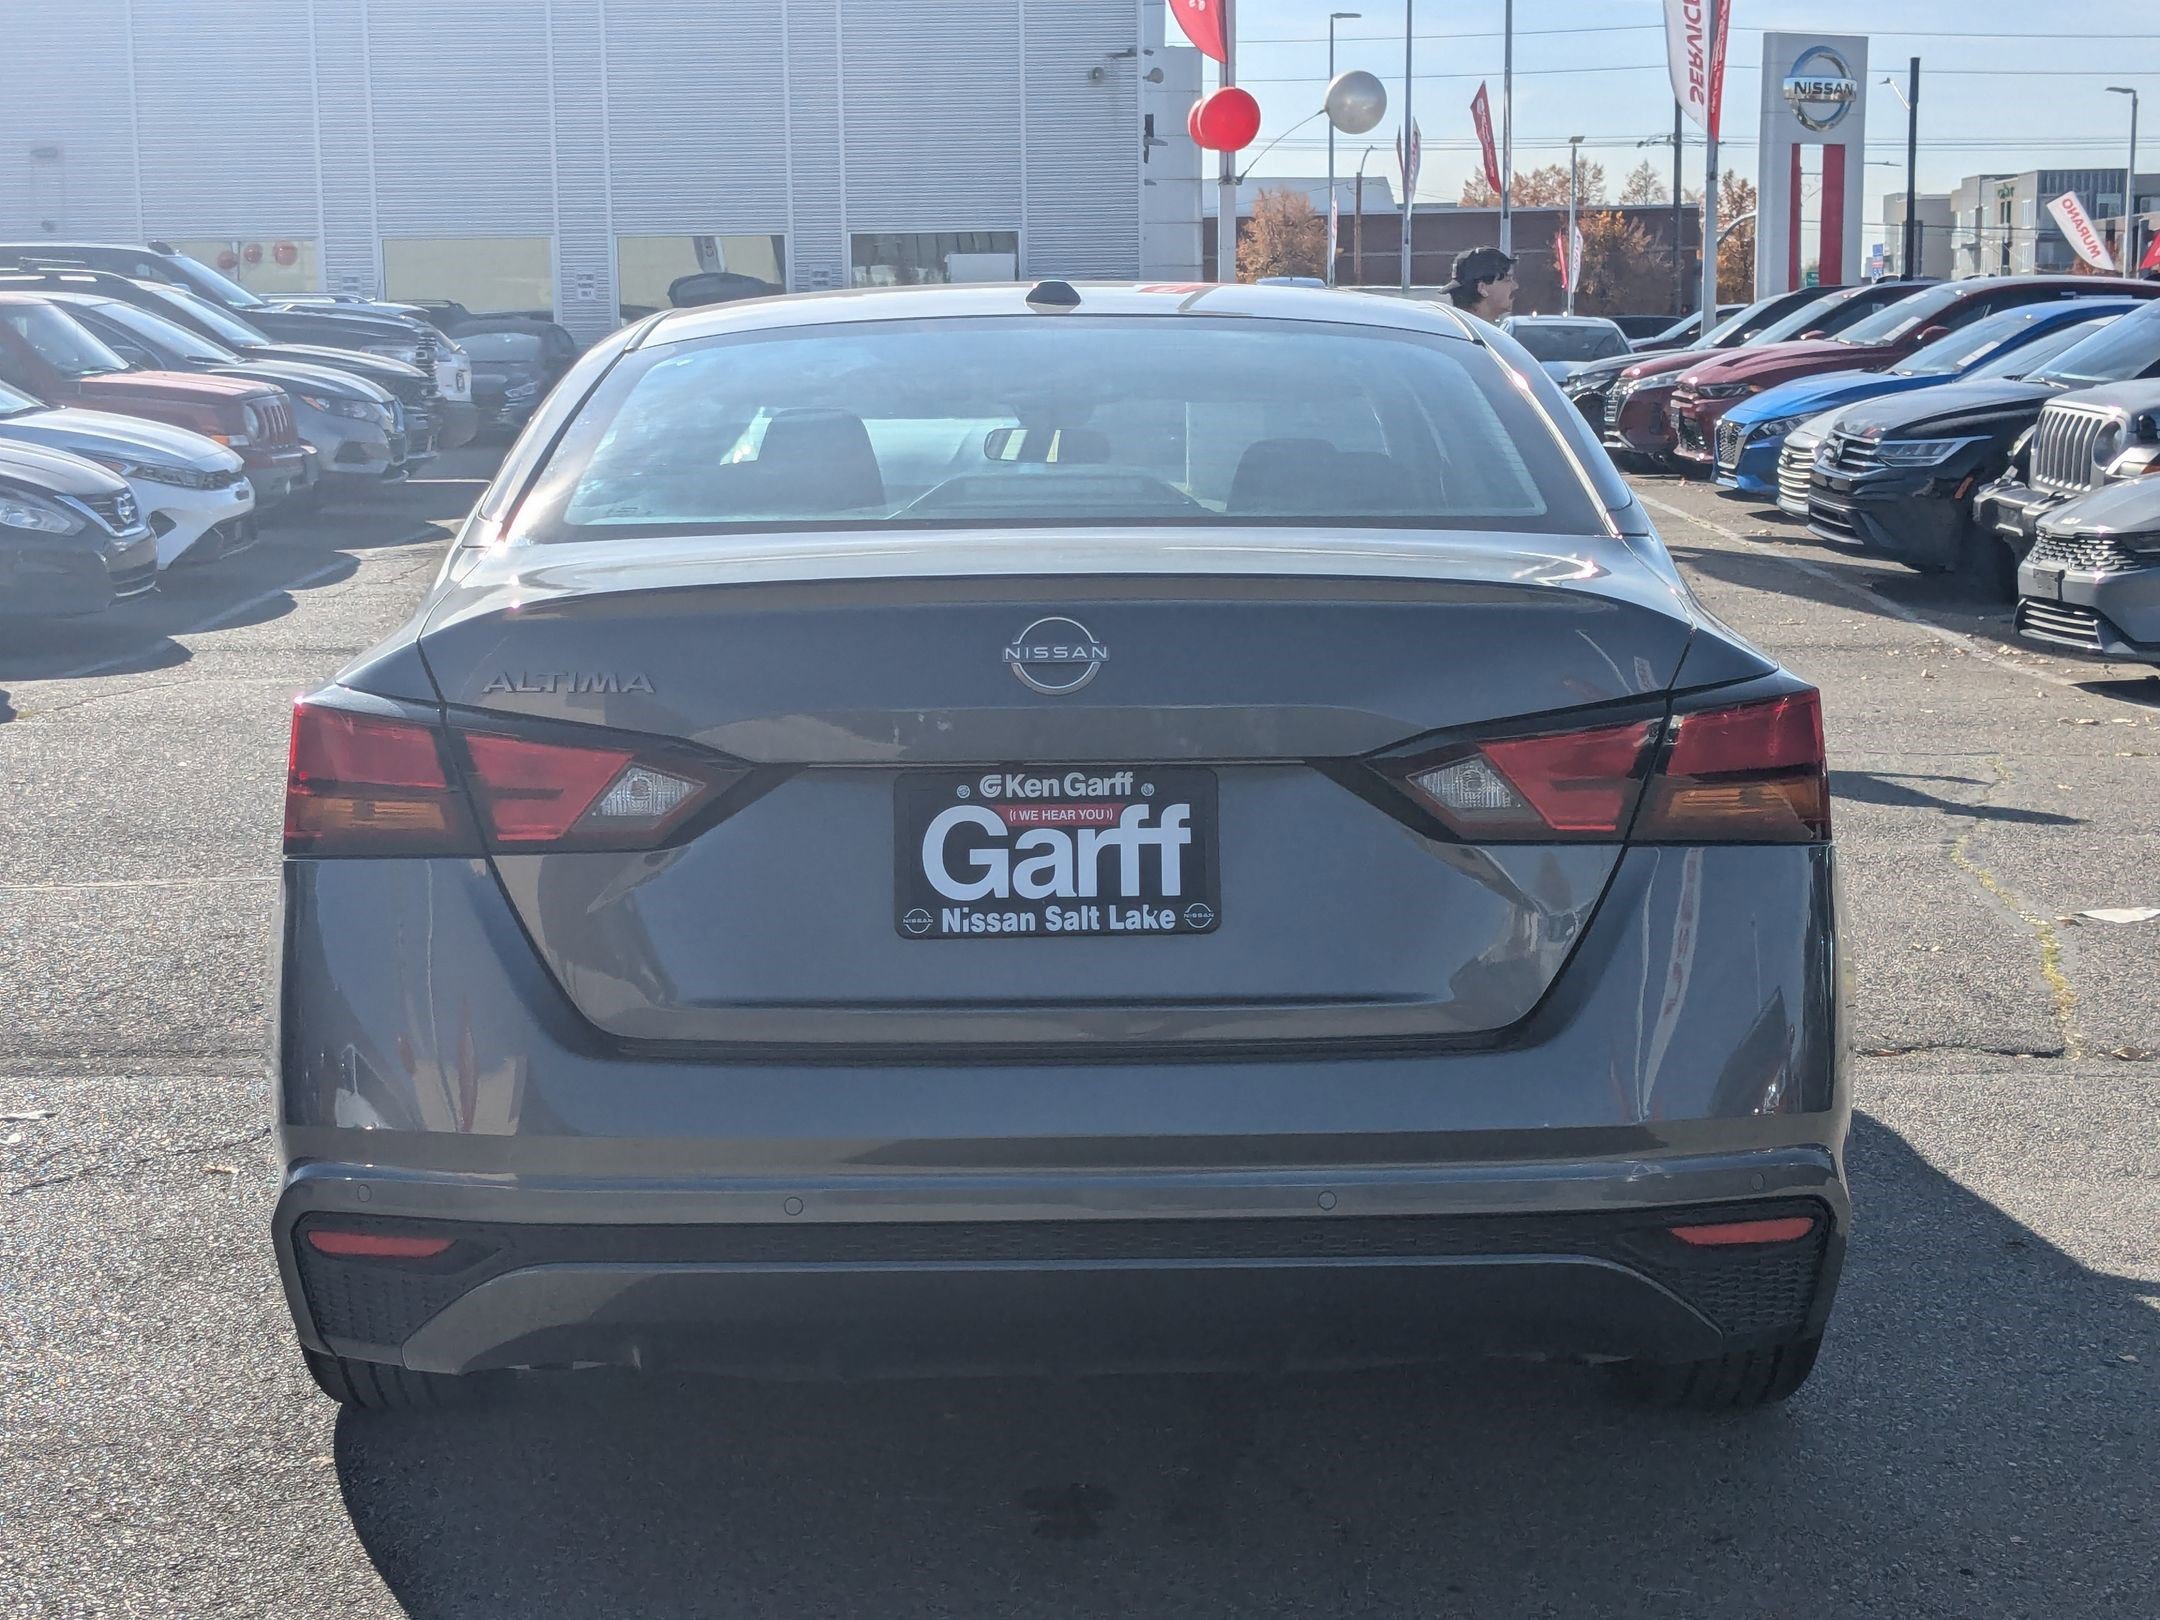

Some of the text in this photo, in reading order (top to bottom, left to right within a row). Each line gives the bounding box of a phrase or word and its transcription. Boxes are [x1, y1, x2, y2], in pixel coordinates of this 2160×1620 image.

[1794, 81, 1853, 95] NISSAN
[1005, 646, 1107, 660] NISSAN
[481, 671, 656, 694] ALTIMA
[1005, 771, 1134, 798] Ken Garff
[1019, 809, 1104, 821] WE HEAR YOU
[922, 803, 1191, 901] Garff
[942, 904, 1176, 933] Nissan Salt Lake
